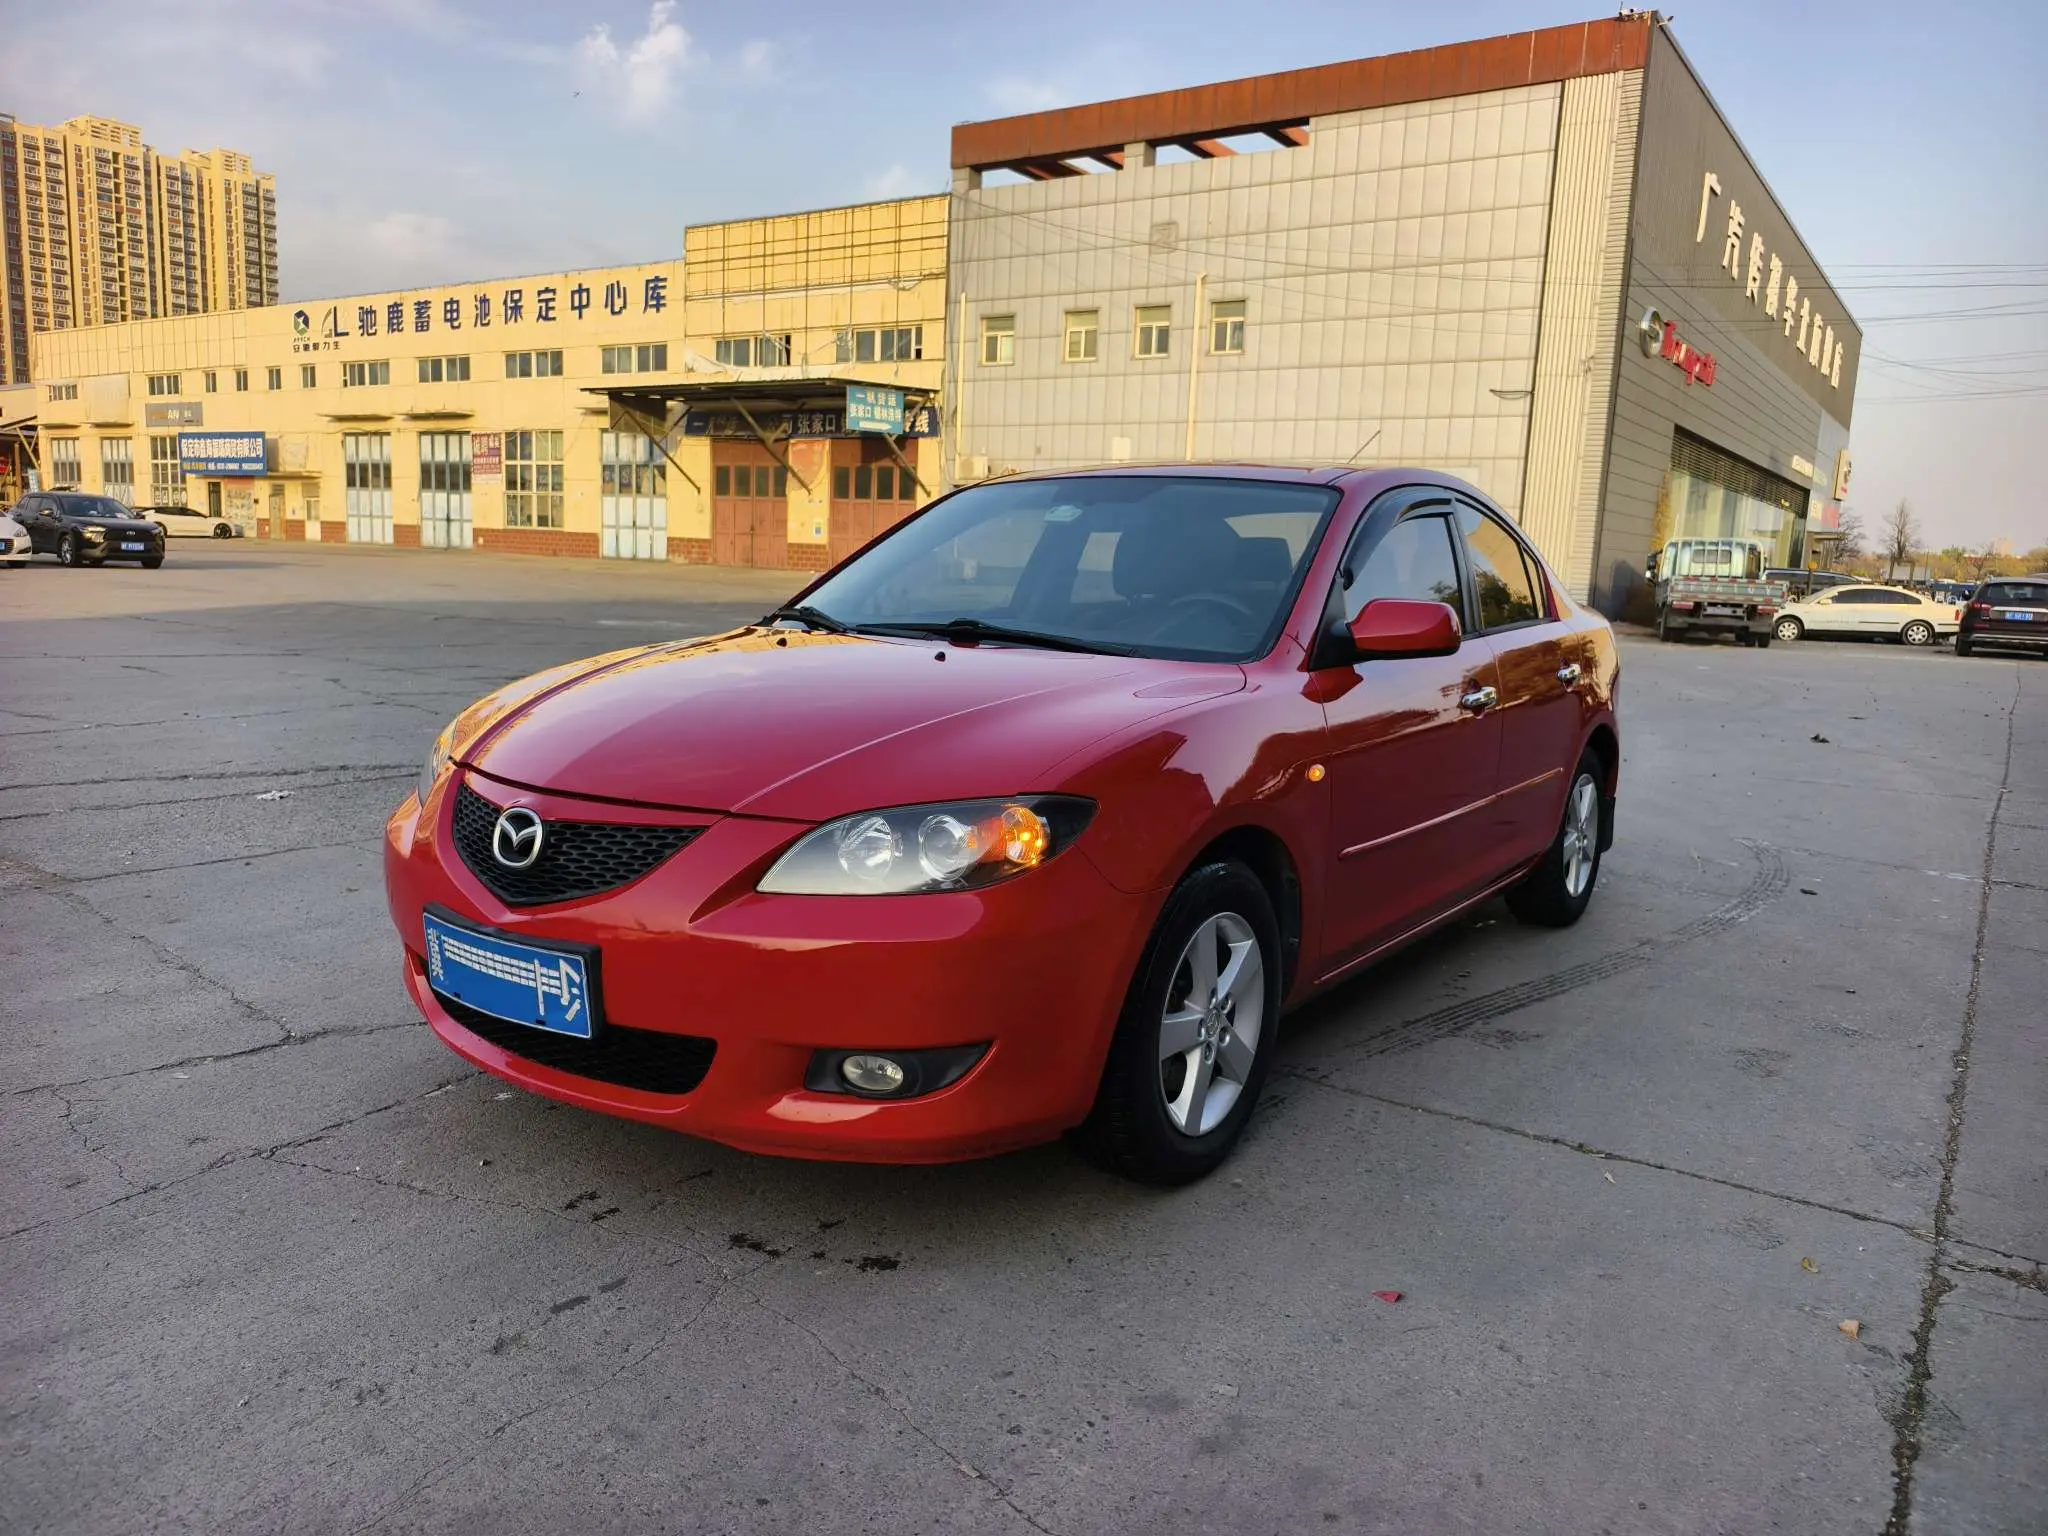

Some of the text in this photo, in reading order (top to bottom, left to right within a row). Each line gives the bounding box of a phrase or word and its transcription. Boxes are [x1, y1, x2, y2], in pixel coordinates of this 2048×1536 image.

[358, 275, 668, 337] 驰鹿蓄电池保定中心库
